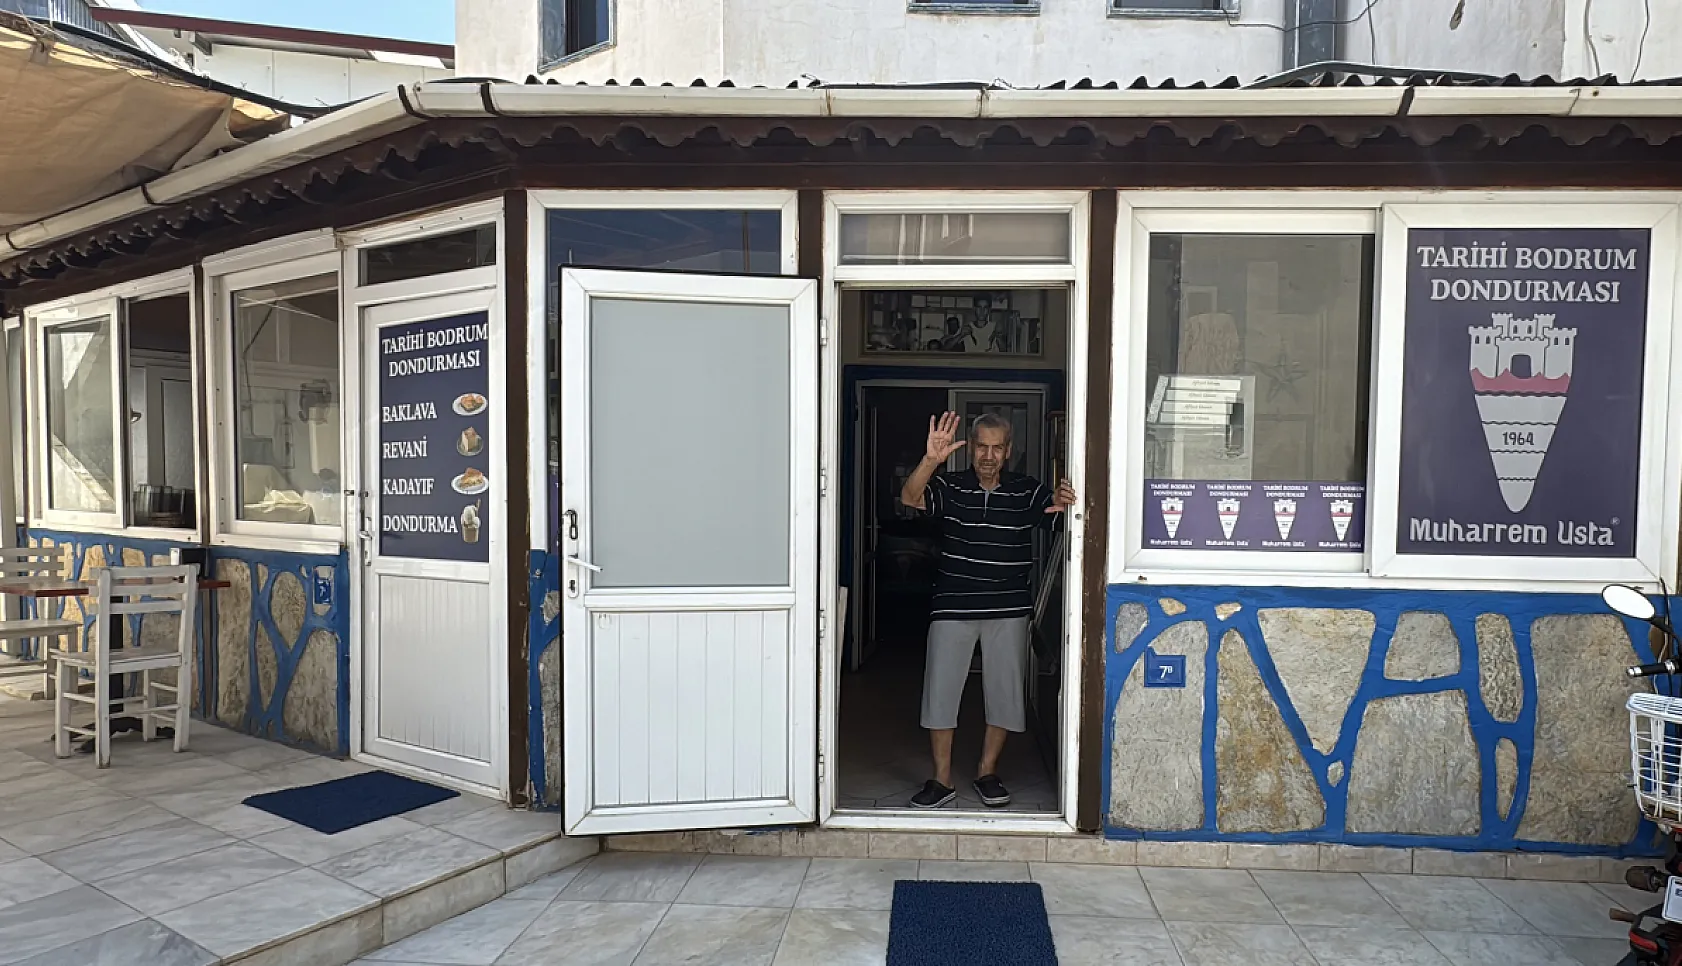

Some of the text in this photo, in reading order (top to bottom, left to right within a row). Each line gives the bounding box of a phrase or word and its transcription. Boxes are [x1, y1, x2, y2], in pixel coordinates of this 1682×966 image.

[1417, 241, 1637, 270] TARİHİ BODRUM
[1430, 279, 1620, 302] DONDURMASI
[382, 323, 488, 354] TARİHİ BODRUM
[389, 350, 481, 377] DONDURMASI
[382, 402, 437, 423] BAKLAVA
[382, 436, 428, 459] REVANİ
[1502, 432, 1535, 446] 1964
[382, 478, 434, 495] KADAYIF
[382, 515, 458, 534] DONDURMA
[1410, 517, 1548, 544] Muharrem
